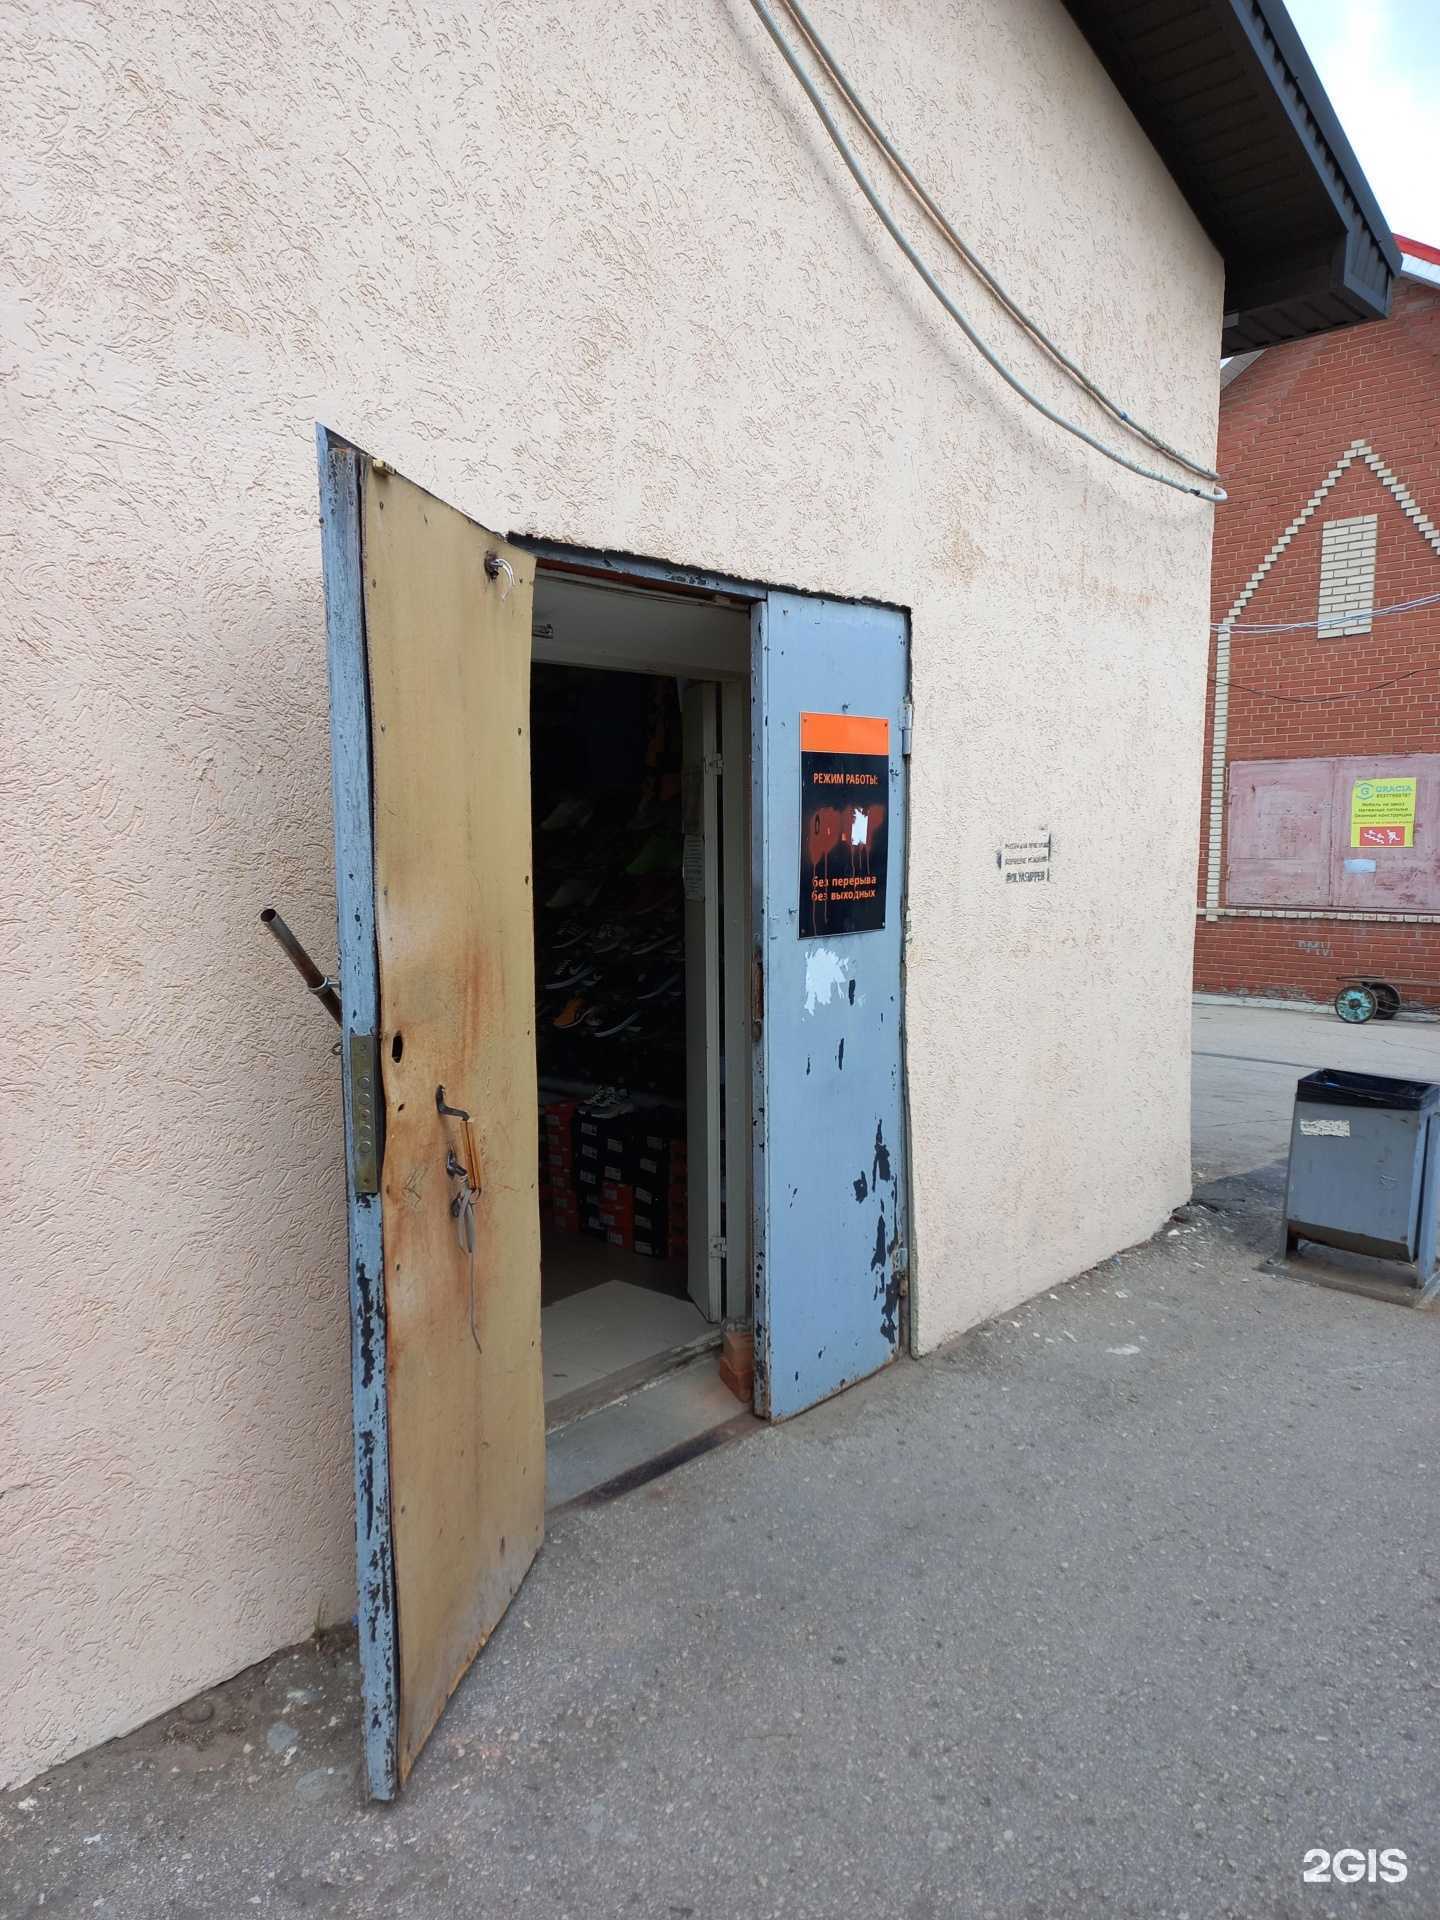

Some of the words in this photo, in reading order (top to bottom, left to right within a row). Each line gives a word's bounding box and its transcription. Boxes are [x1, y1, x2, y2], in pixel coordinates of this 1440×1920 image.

[813, 772, 844, 785] РЕЖИМ
[845, 773, 879, 785] РАБОТЫ:
[812, 876, 829, 887] без
[832, 876, 877, 888] перерыва
[811, 889, 828, 901] без
[831, 889, 876, 901] выходных
